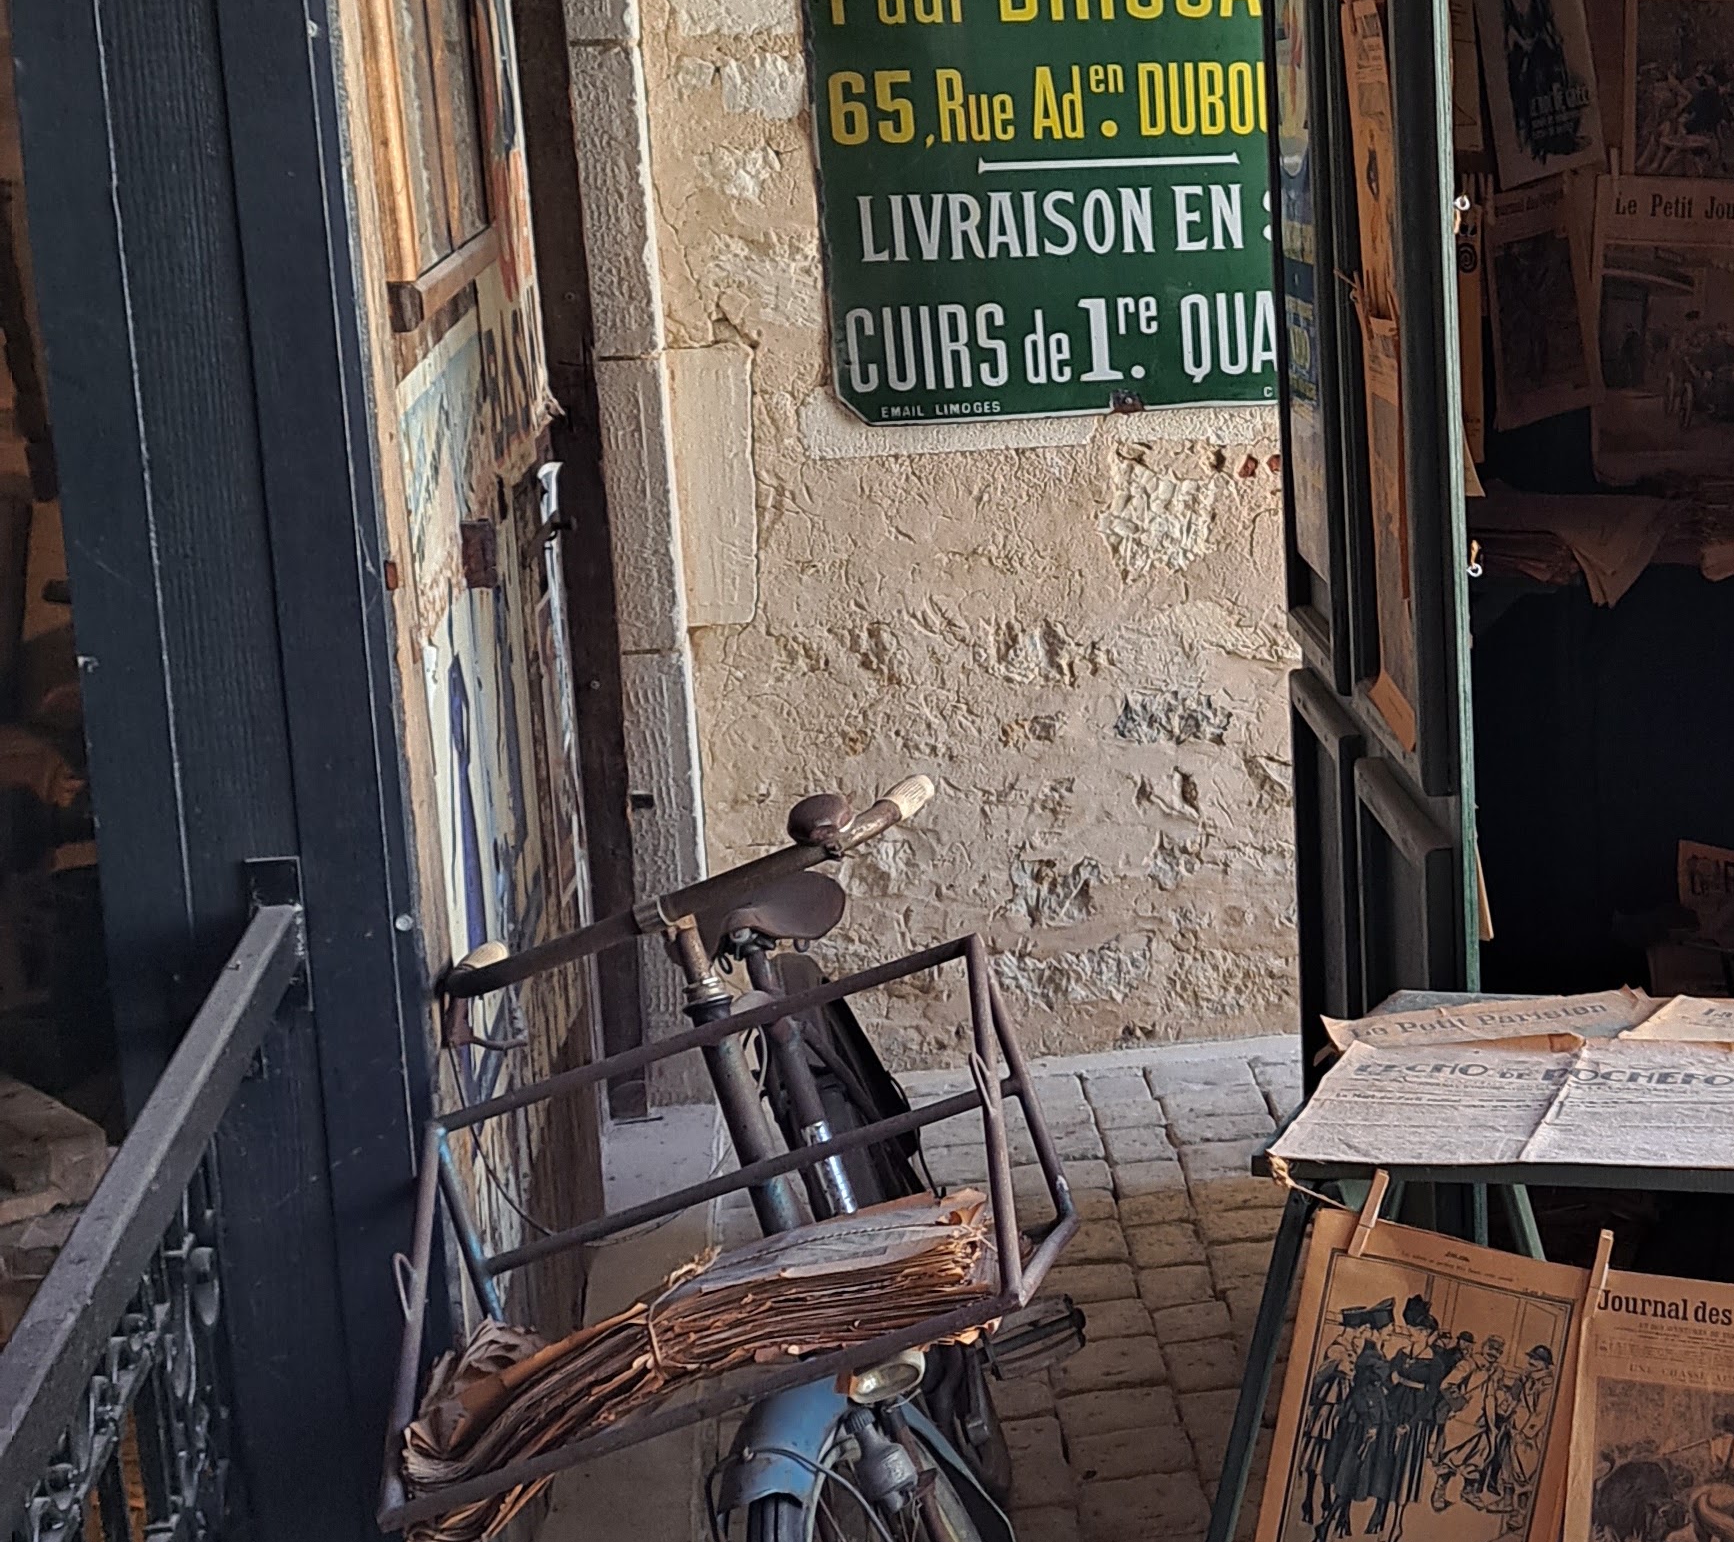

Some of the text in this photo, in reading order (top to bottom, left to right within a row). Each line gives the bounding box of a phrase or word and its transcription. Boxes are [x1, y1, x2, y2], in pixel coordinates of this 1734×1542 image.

[1615, 192, 1637, 216] Le
[1650, 192, 1693, 219] Petit
[855, 187, 1155, 263] LIVRAISON
[1170, 183, 1244, 252] EN
[845, 301, 1009, 394] CUIRS
[1024, 309, 1072, 384] de
[1179, 290, 1277, 384] QUA
[881, 404, 924, 419] EMAIL
[935, 401, 1001, 415] LIMOGES
[1395, 1017, 1473, 1034] Petit
[1478, 1004, 1607, 1026] Parisien
[1597, 1290, 1688, 1321] Journal
[1694, 1301, 1732, 1326] des
